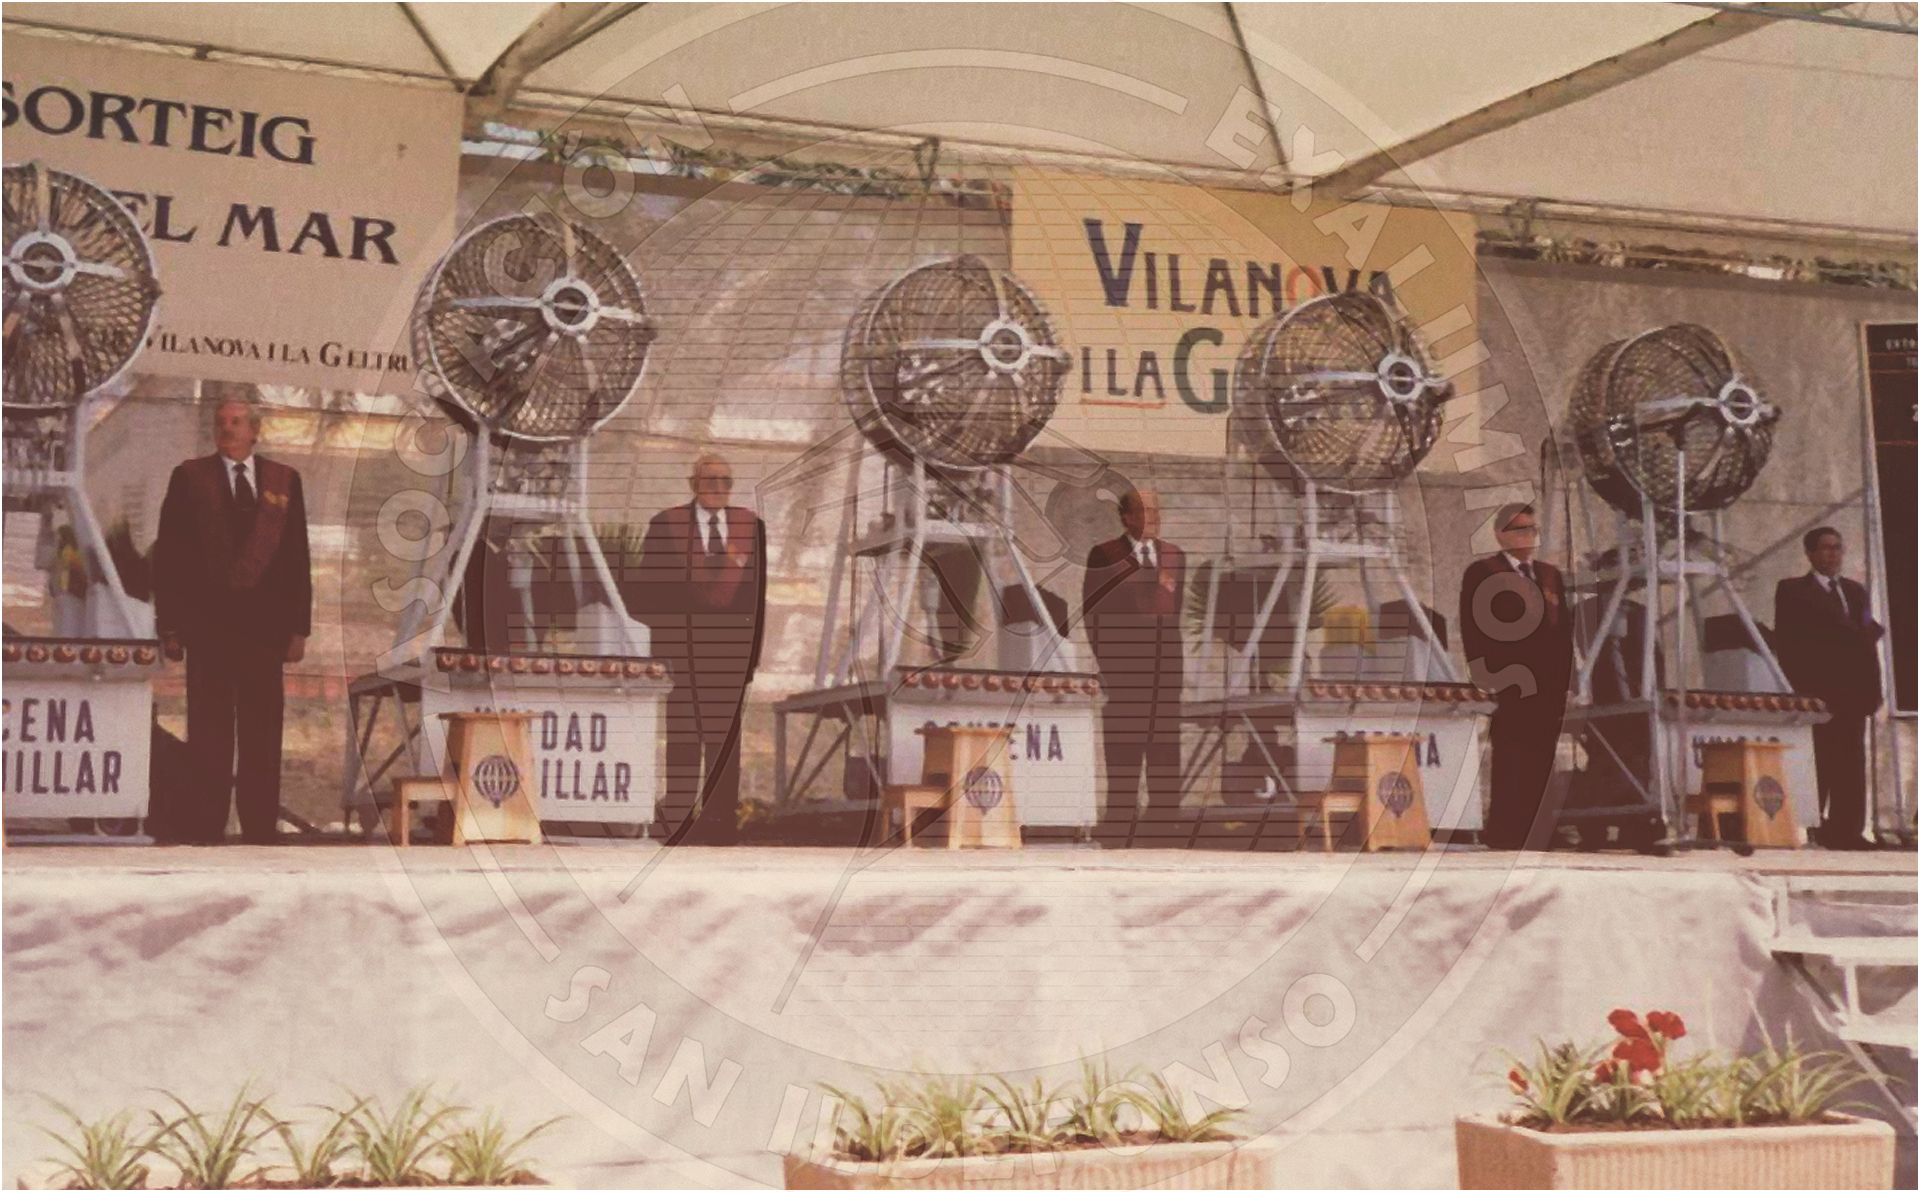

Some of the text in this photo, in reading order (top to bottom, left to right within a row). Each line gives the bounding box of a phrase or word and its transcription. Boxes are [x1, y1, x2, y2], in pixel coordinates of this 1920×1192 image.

[216, 203, 399, 264] MAR
[1106, 348, 1166, 399] LA
[2, 750, 122, 794] ILLAR
[540, 758, 632, 803] ILLAR
